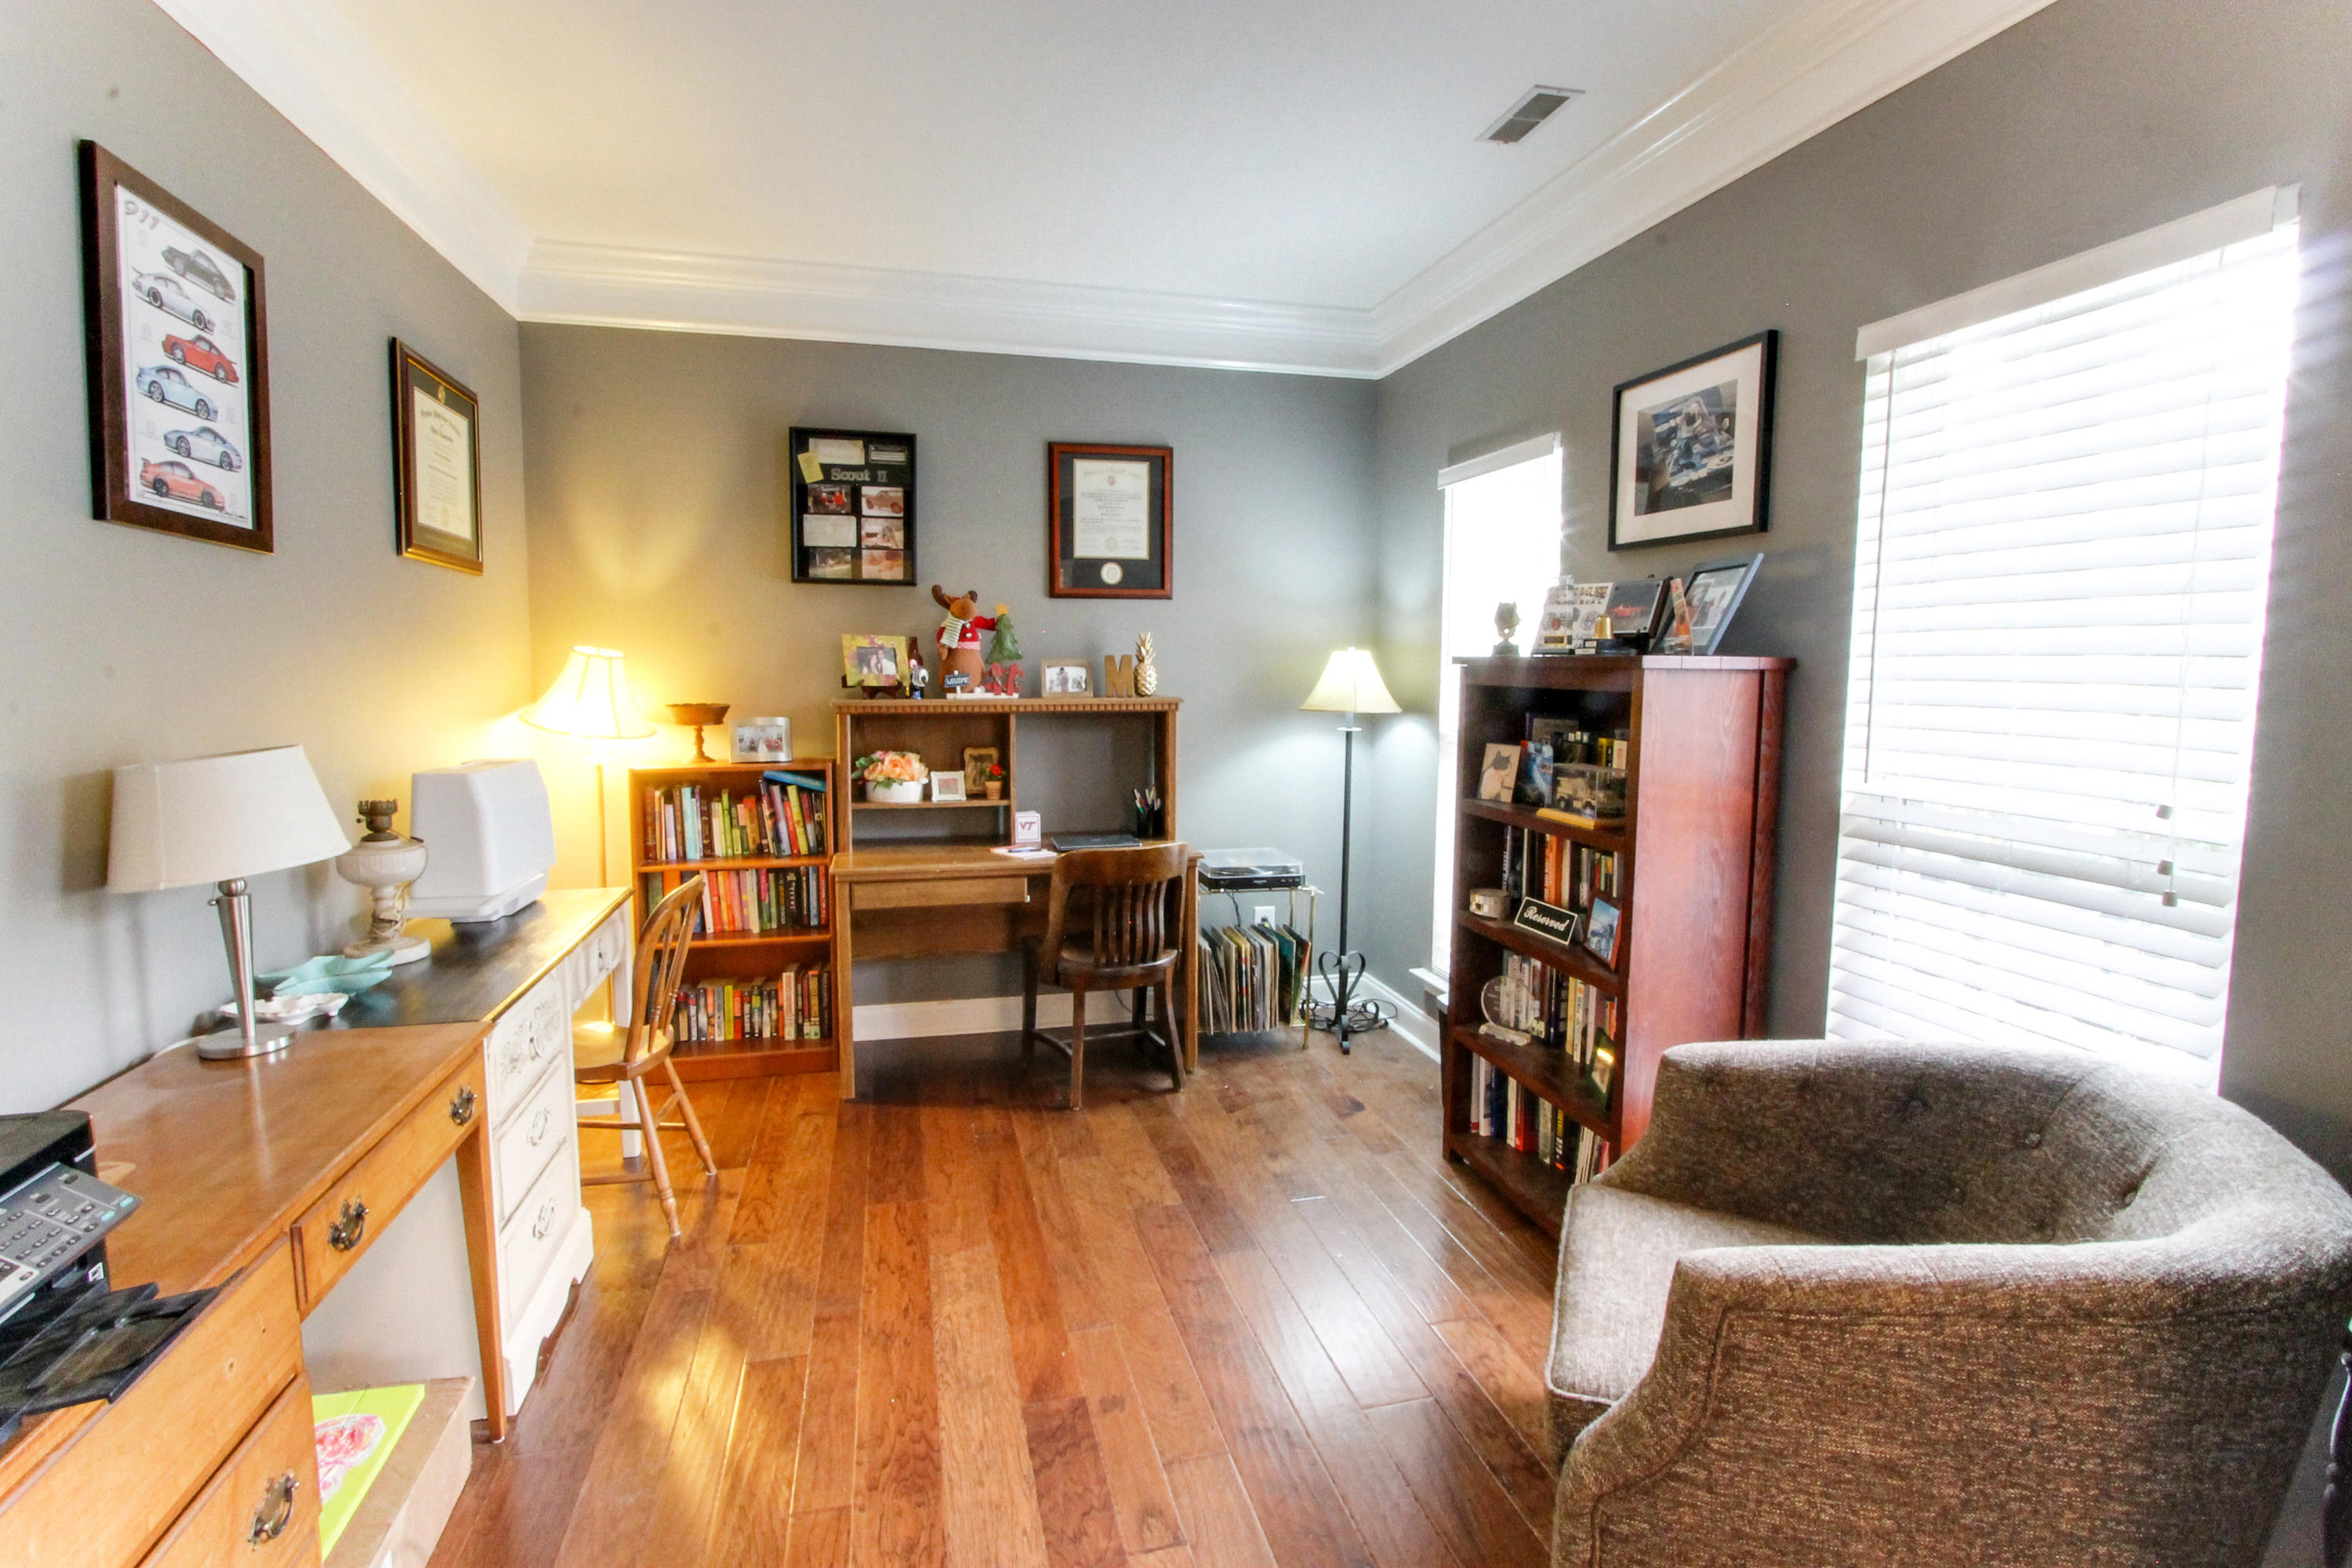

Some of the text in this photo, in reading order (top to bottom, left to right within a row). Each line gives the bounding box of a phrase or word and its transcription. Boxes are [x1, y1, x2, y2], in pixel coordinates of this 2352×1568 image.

[125, 199, 161, 230] 911
[831, 468, 870, 481] Scout
[1105, 655, 1134, 697] M
[1019, 821, 1036, 831] VT
[1523, 906, 1570, 931] Reserved
